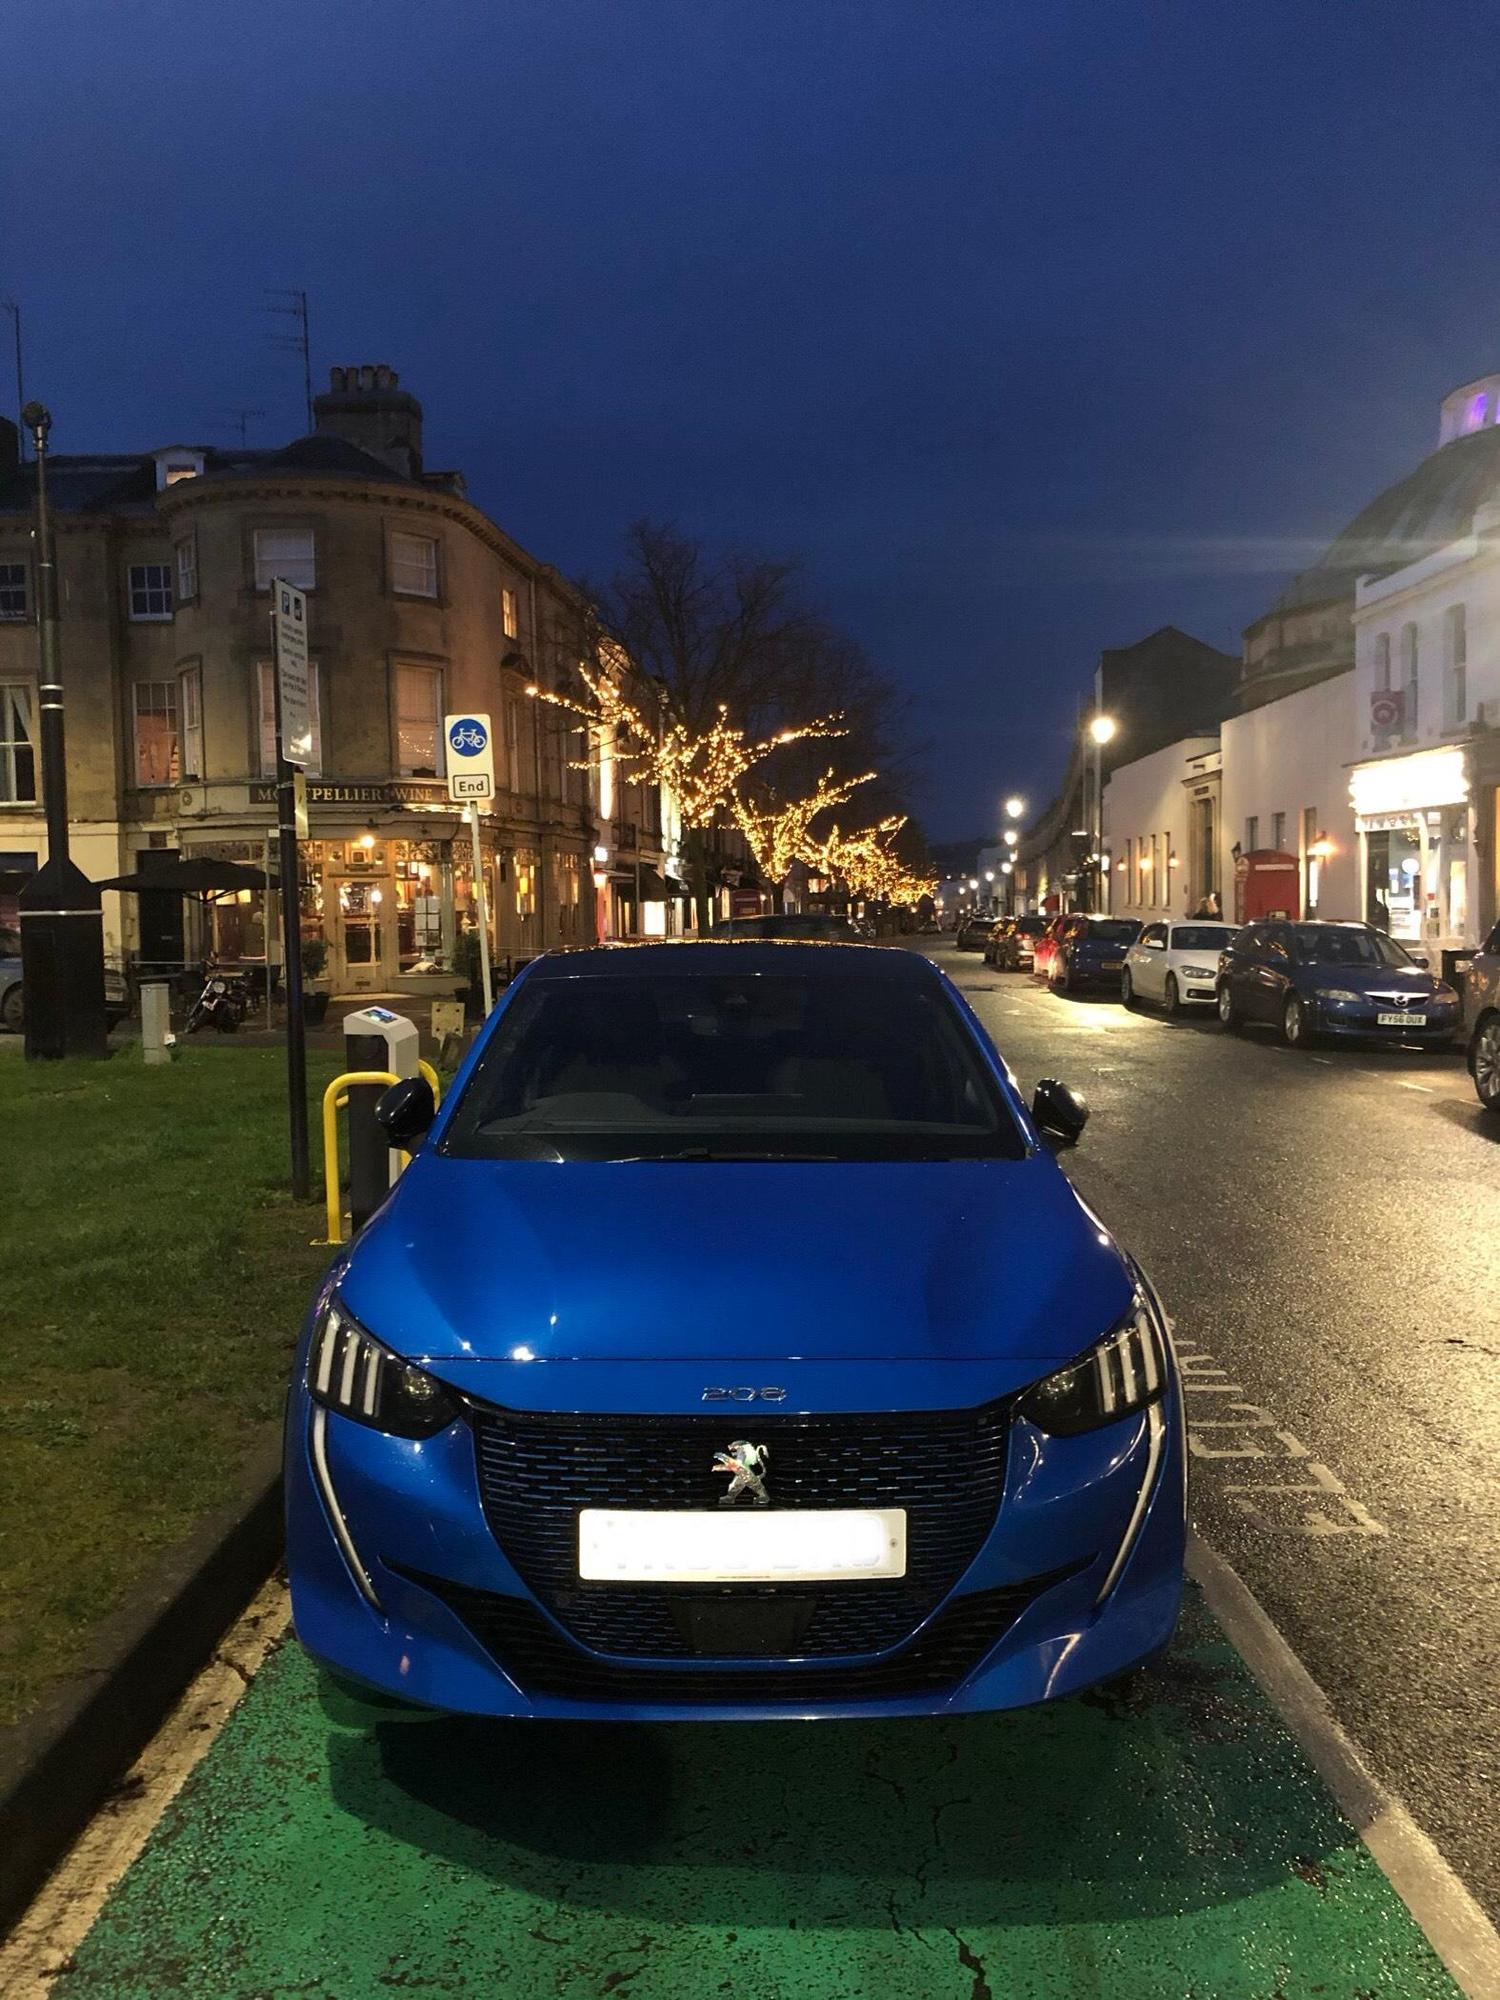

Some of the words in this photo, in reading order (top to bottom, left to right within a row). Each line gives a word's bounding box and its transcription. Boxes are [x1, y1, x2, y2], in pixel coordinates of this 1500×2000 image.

[459, 781, 484, 792] End
[258, 788, 382, 801] MPELLIER
[395, 788, 432, 801] WINE
[702, 1387, 786, 1401] 208
